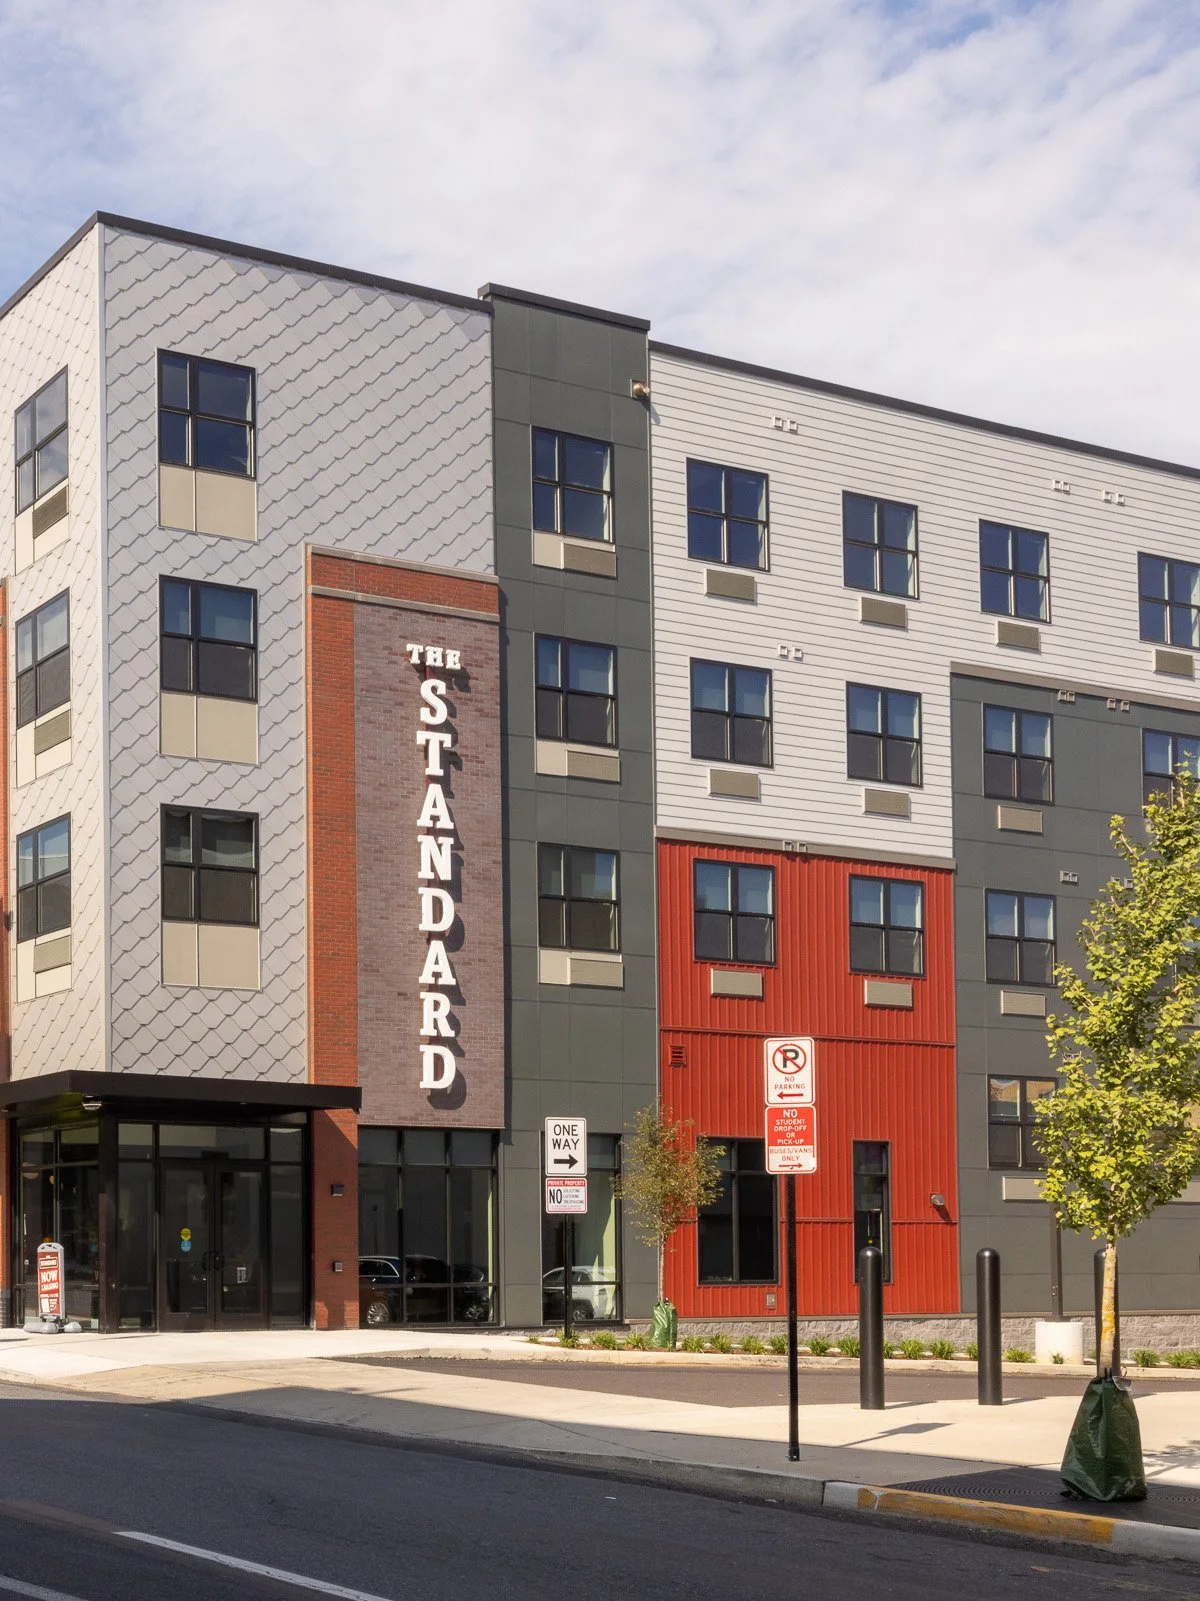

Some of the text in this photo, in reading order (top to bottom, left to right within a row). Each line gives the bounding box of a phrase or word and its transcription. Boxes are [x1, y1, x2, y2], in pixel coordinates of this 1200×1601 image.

[406, 643, 462, 670] THE
[416, 678, 456, 1089] STANDARD
[783, 1108, 798, 1118] NO
[553, 1124, 579, 1136] ONE
[552, 1138, 580, 1150] WAY
[549, 1188, 563, 1204] NO
[41, 1270, 58, 1283] NOW
